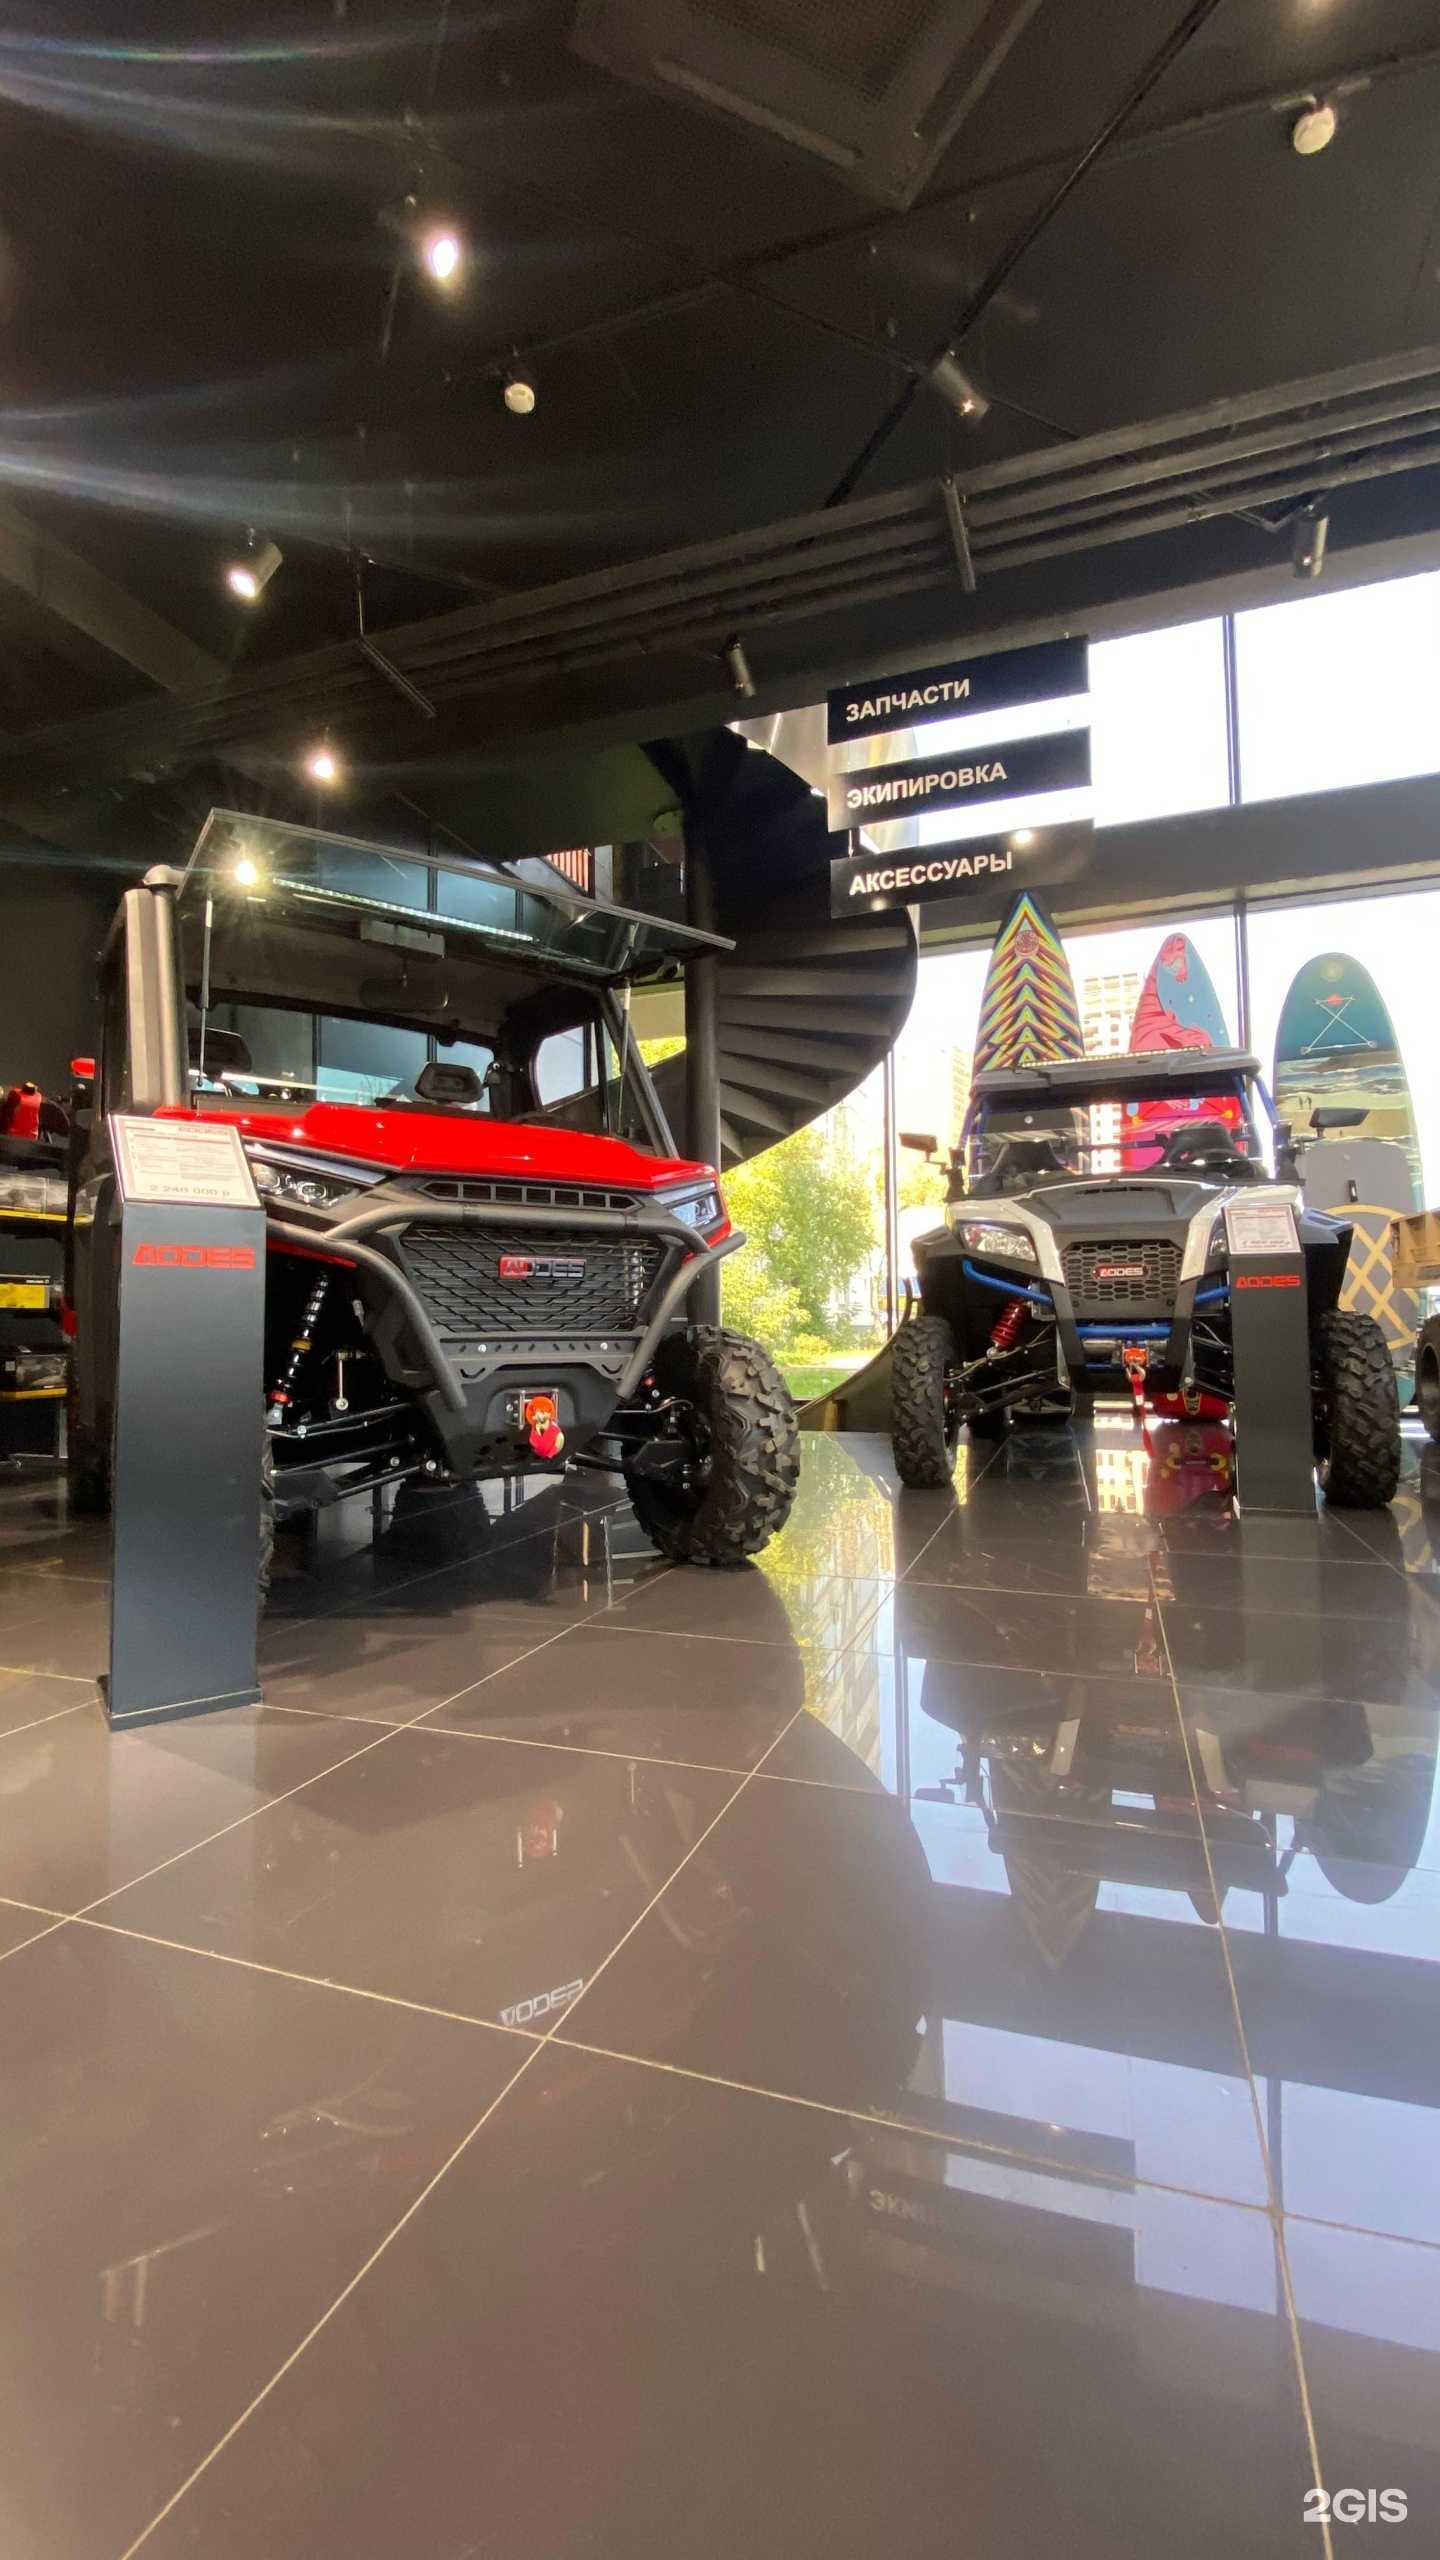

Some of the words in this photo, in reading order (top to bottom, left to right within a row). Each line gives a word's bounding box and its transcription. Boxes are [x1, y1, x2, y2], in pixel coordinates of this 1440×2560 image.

[846, 678, 970, 722] ЗАПЧАСТИ
[847, 762, 1008, 809] ЭКИПИРОВКА
[849, 851, 1013, 896] АКСЕССУАРЫ
[132, 1243, 256, 1270] AODES
[499, 1256, 586, 1280] AODES
[1100, 1267, 1144, 1277] AODES
[1236, 1274, 1301, 1289] AODES
